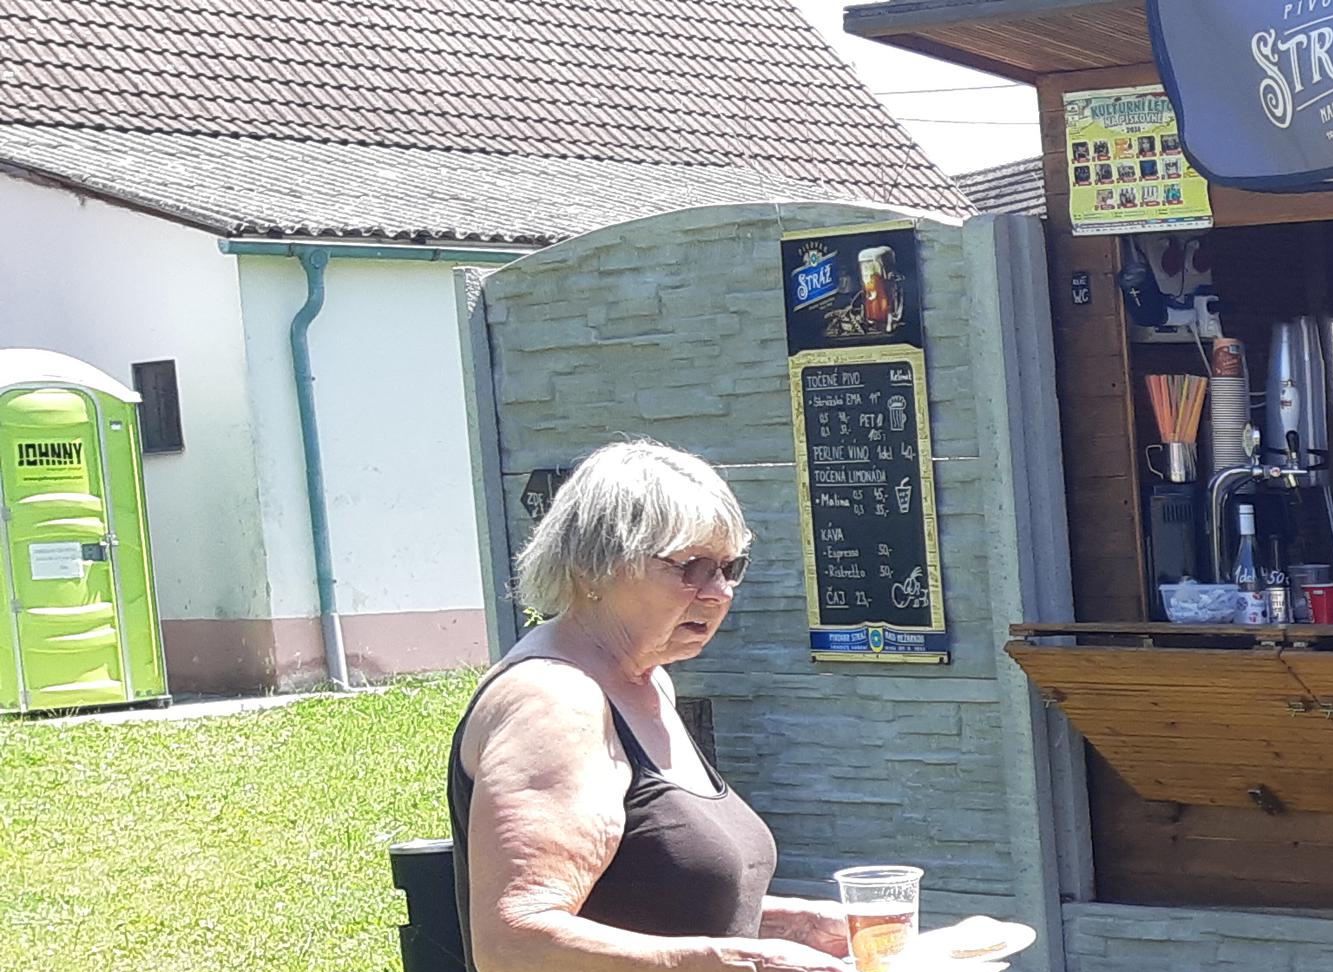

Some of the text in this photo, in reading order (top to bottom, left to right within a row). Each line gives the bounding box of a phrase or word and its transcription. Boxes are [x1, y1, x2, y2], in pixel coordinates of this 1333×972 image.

[1091, 98, 1145, 117] KULTURNÍ
[797, 264, 832, 300] STRÁŽ
[806, 368, 838, 387] TOČENÉ
[842, 372, 861, 385] PIVO
[845, 393, 862, 405] EMA
[859, 414, 874, 427] PET
[18, 442, 82, 467] JOHNNY
[813, 439, 844, 461] PERLIVÉ
[848, 438, 869, 461] VÍNO
[814, 464, 887, 483] TOČENÁ LIMONÁDA
[821, 494, 850, 507] Malina
[820, 522, 845, 542] KÁVA
[825, 587, 846, 606] ČAJ
